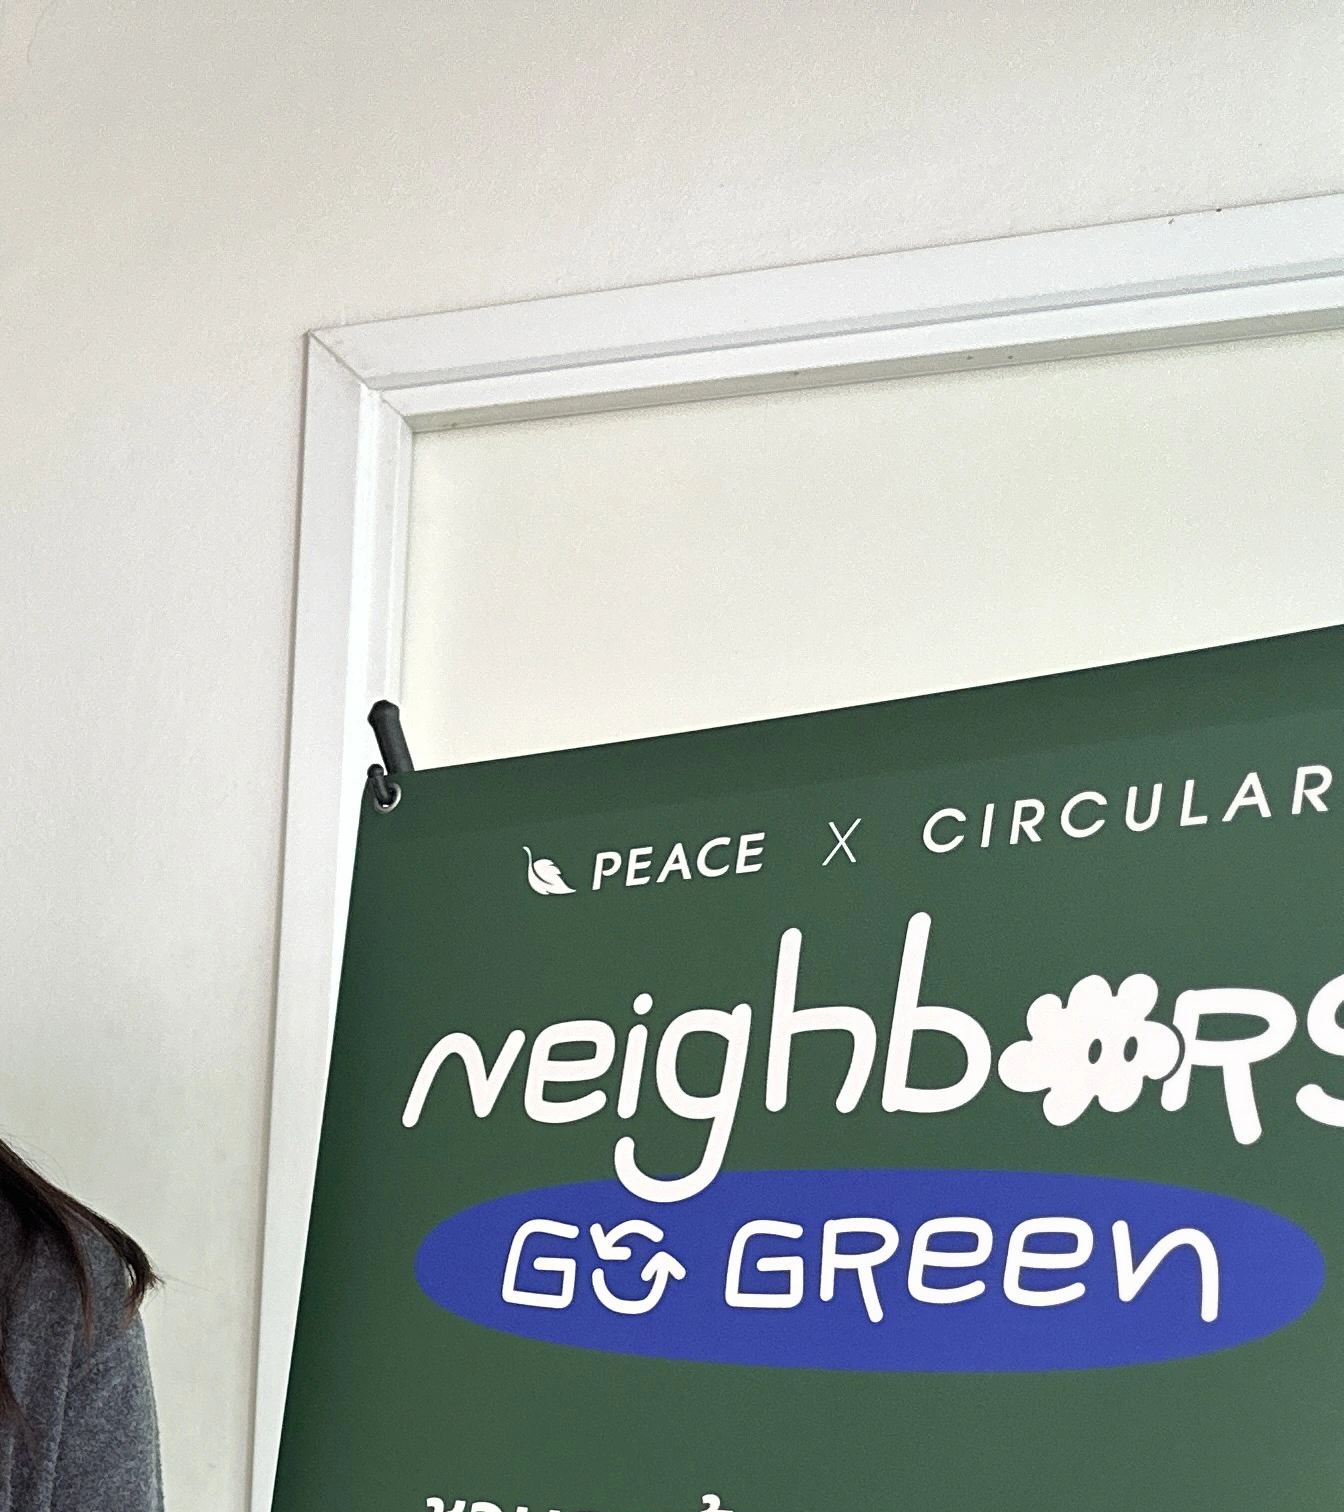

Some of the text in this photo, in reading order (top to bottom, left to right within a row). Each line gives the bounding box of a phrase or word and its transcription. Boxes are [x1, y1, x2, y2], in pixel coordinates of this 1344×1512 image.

[593, 765, 1332, 890] PEACE X CIRCULAR
